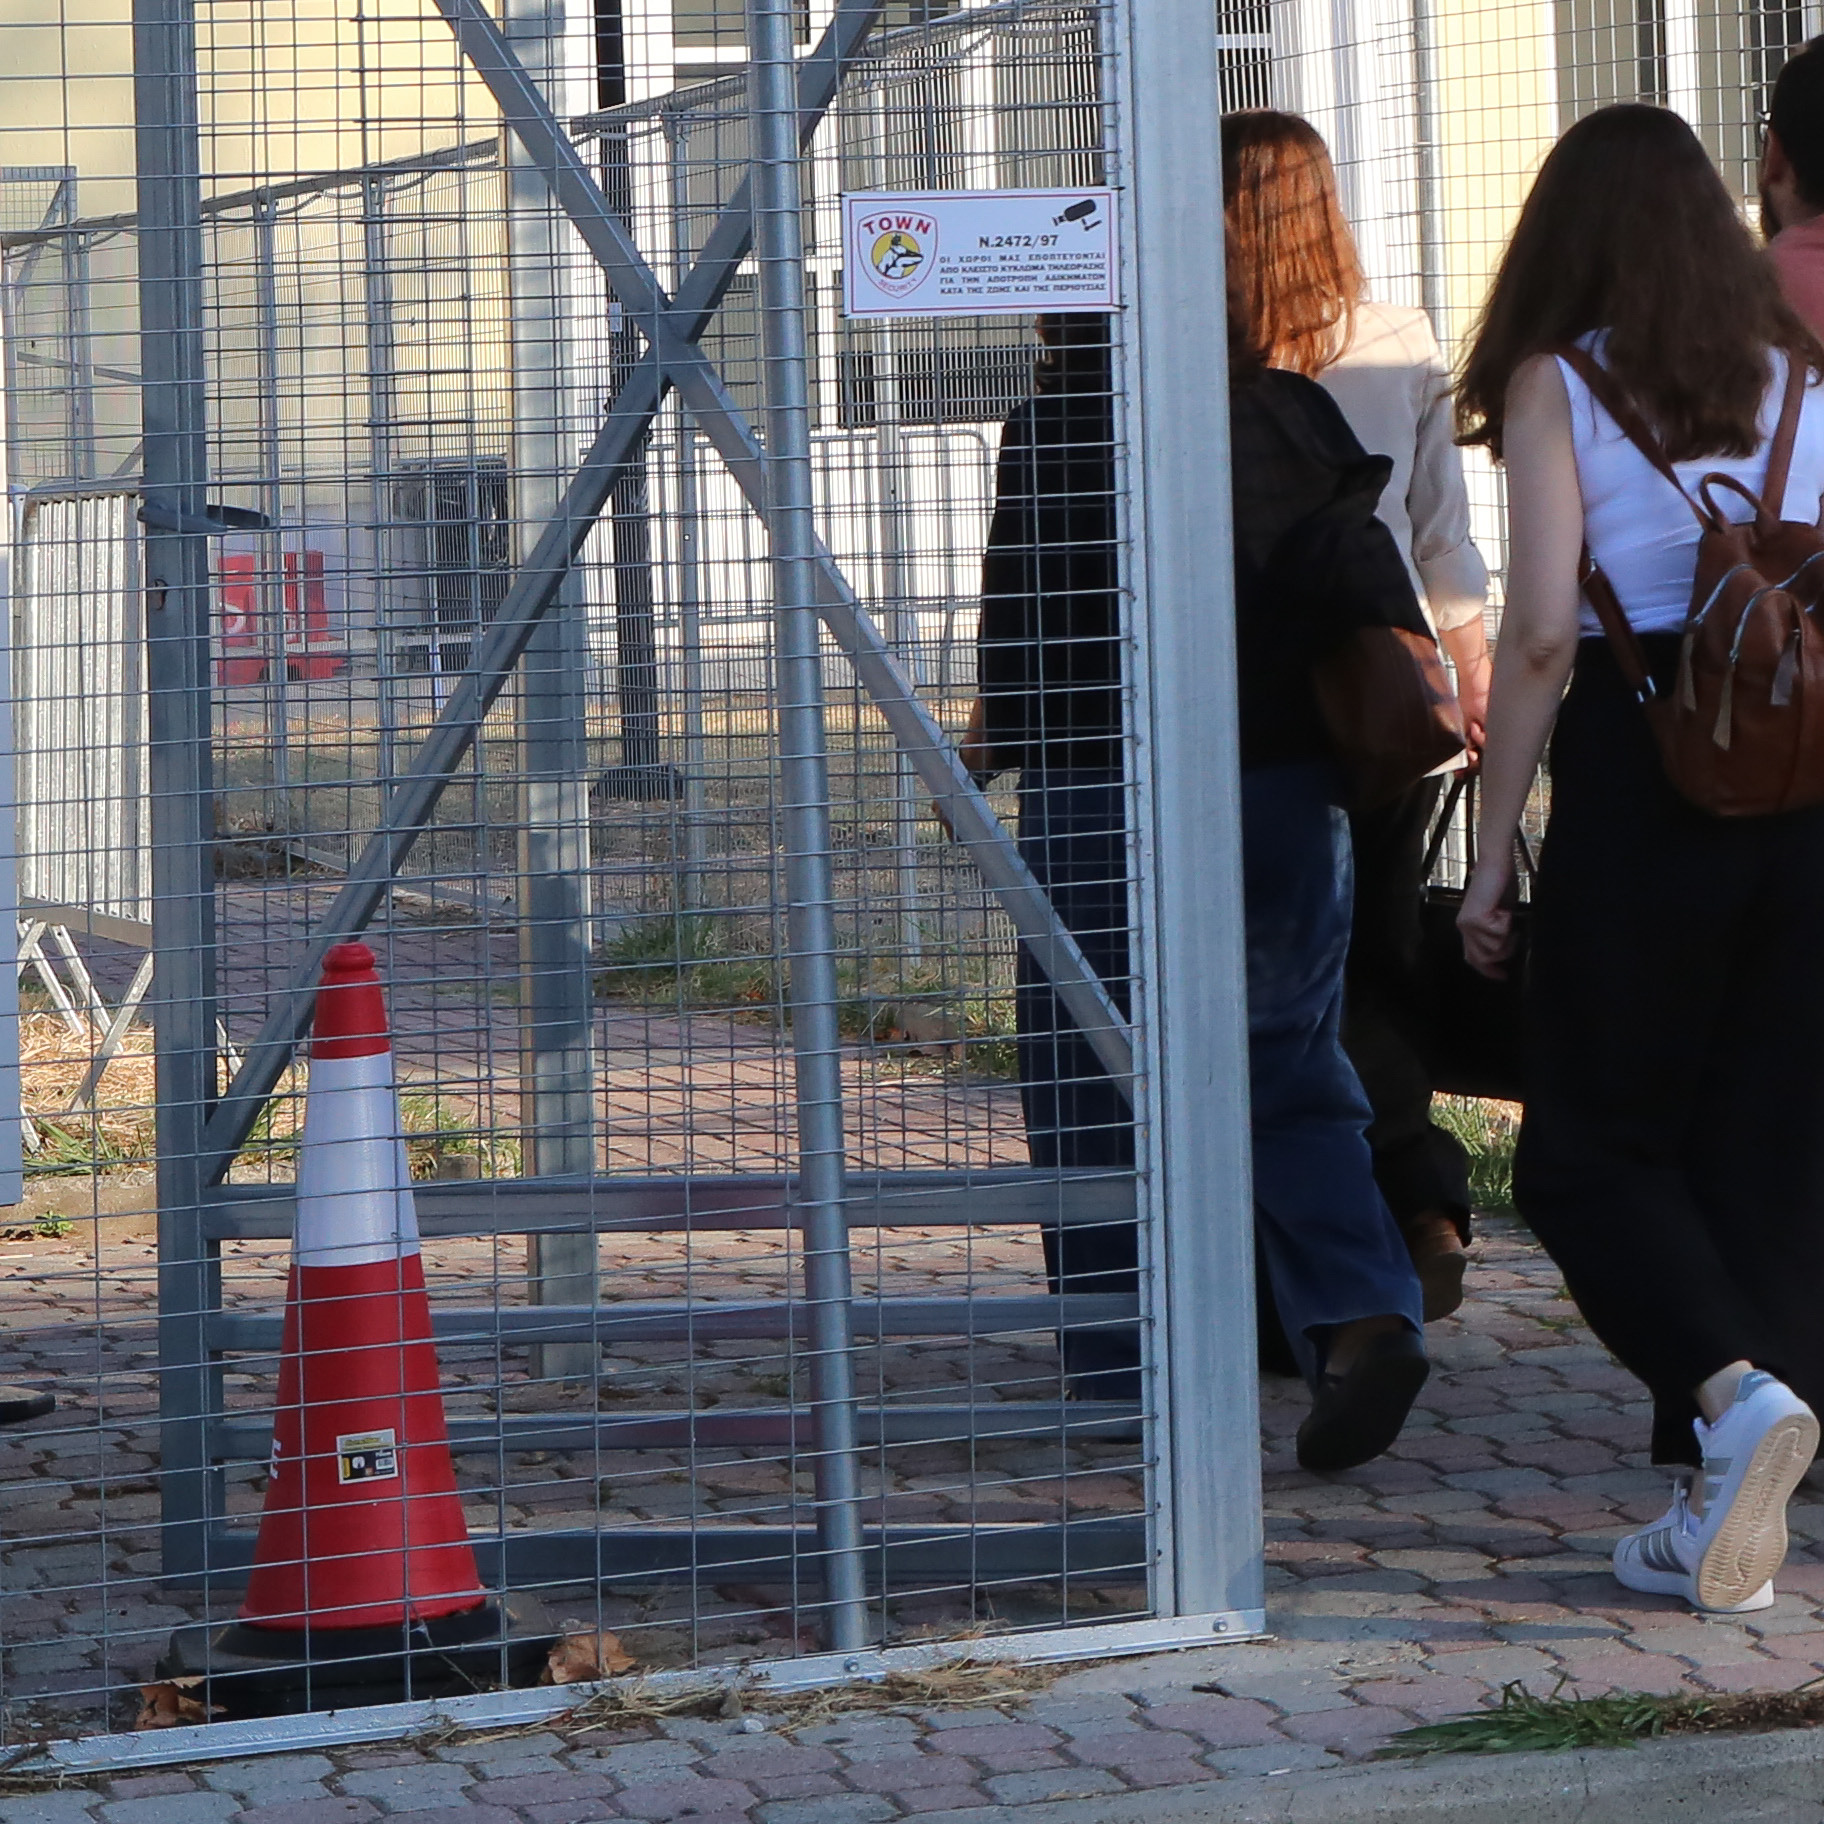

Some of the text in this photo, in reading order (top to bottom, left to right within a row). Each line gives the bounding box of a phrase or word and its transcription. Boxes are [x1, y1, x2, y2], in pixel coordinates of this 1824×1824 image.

[862, 216, 932, 235] TOWN
[940, 266, 959, 274] ΑΠΟ
[967, 286, 983, 294] ΤΗΣ
[1033, 284, 1049, 292] ΤΗΣ
